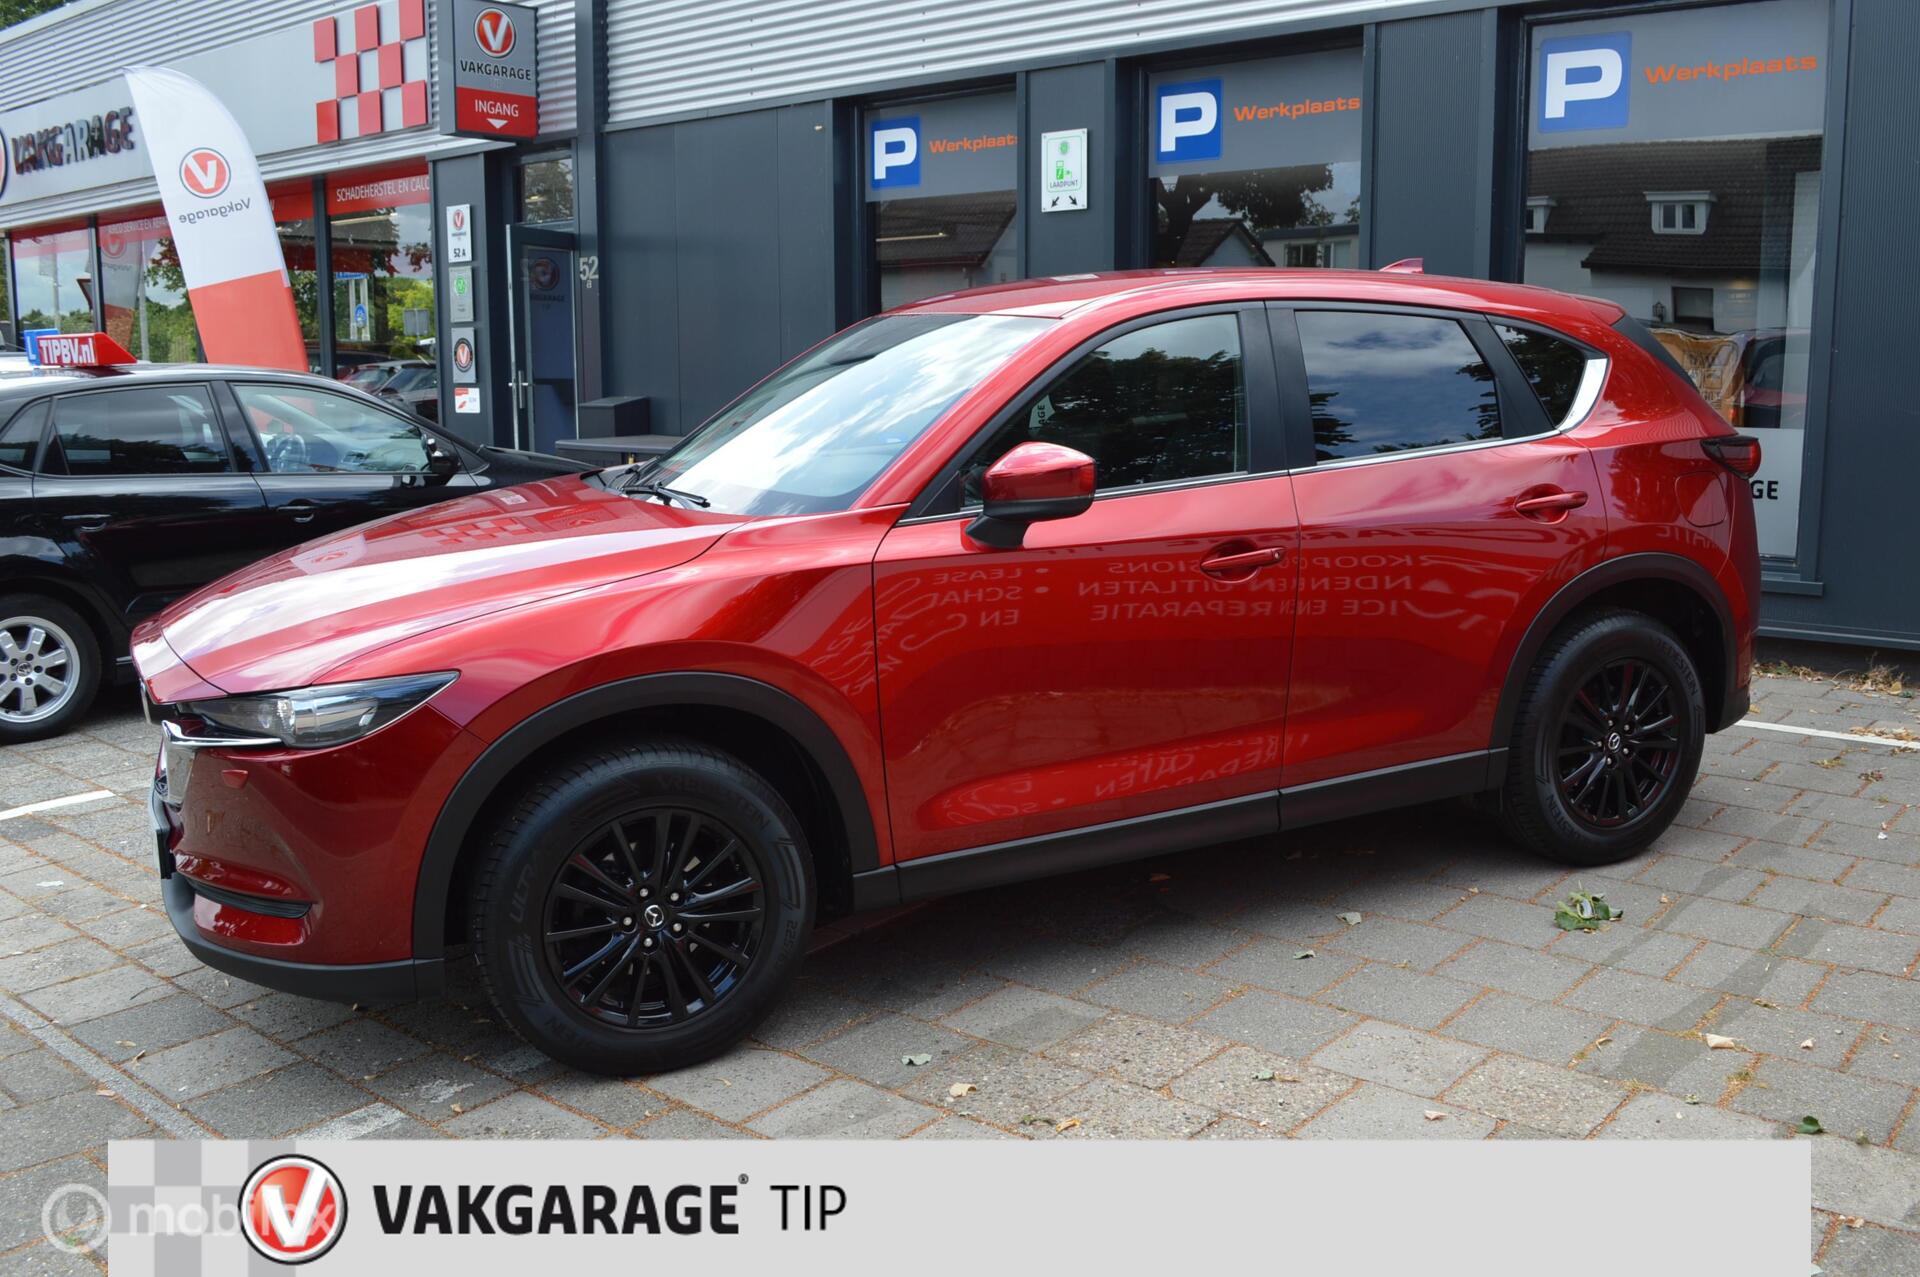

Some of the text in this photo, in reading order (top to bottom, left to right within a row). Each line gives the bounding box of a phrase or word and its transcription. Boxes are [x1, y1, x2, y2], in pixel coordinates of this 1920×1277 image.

[460, 60, 532, 81] VAKGARAGE
[1544, 48, 1622, 119] P
[1644, 55, 1818, 85] Werkplaats
[474, 99, 519, 117] INGANG
[1233, 95, 1361, 123] Werkplaats
[1160, 91, 1217, 153] P
[11, 106, 135, 176] VAKGARAGE
[873, 126, 918, 180] P
[336, 183, 397, 203] SCHADEHERSTEL
[398, 181, 409, 194] EN
[1049, 179, 1078, 189] LAADPUNT
[579, 255, 599, 281] 52
[40, 337, 96, 364] TIPBV.nl
